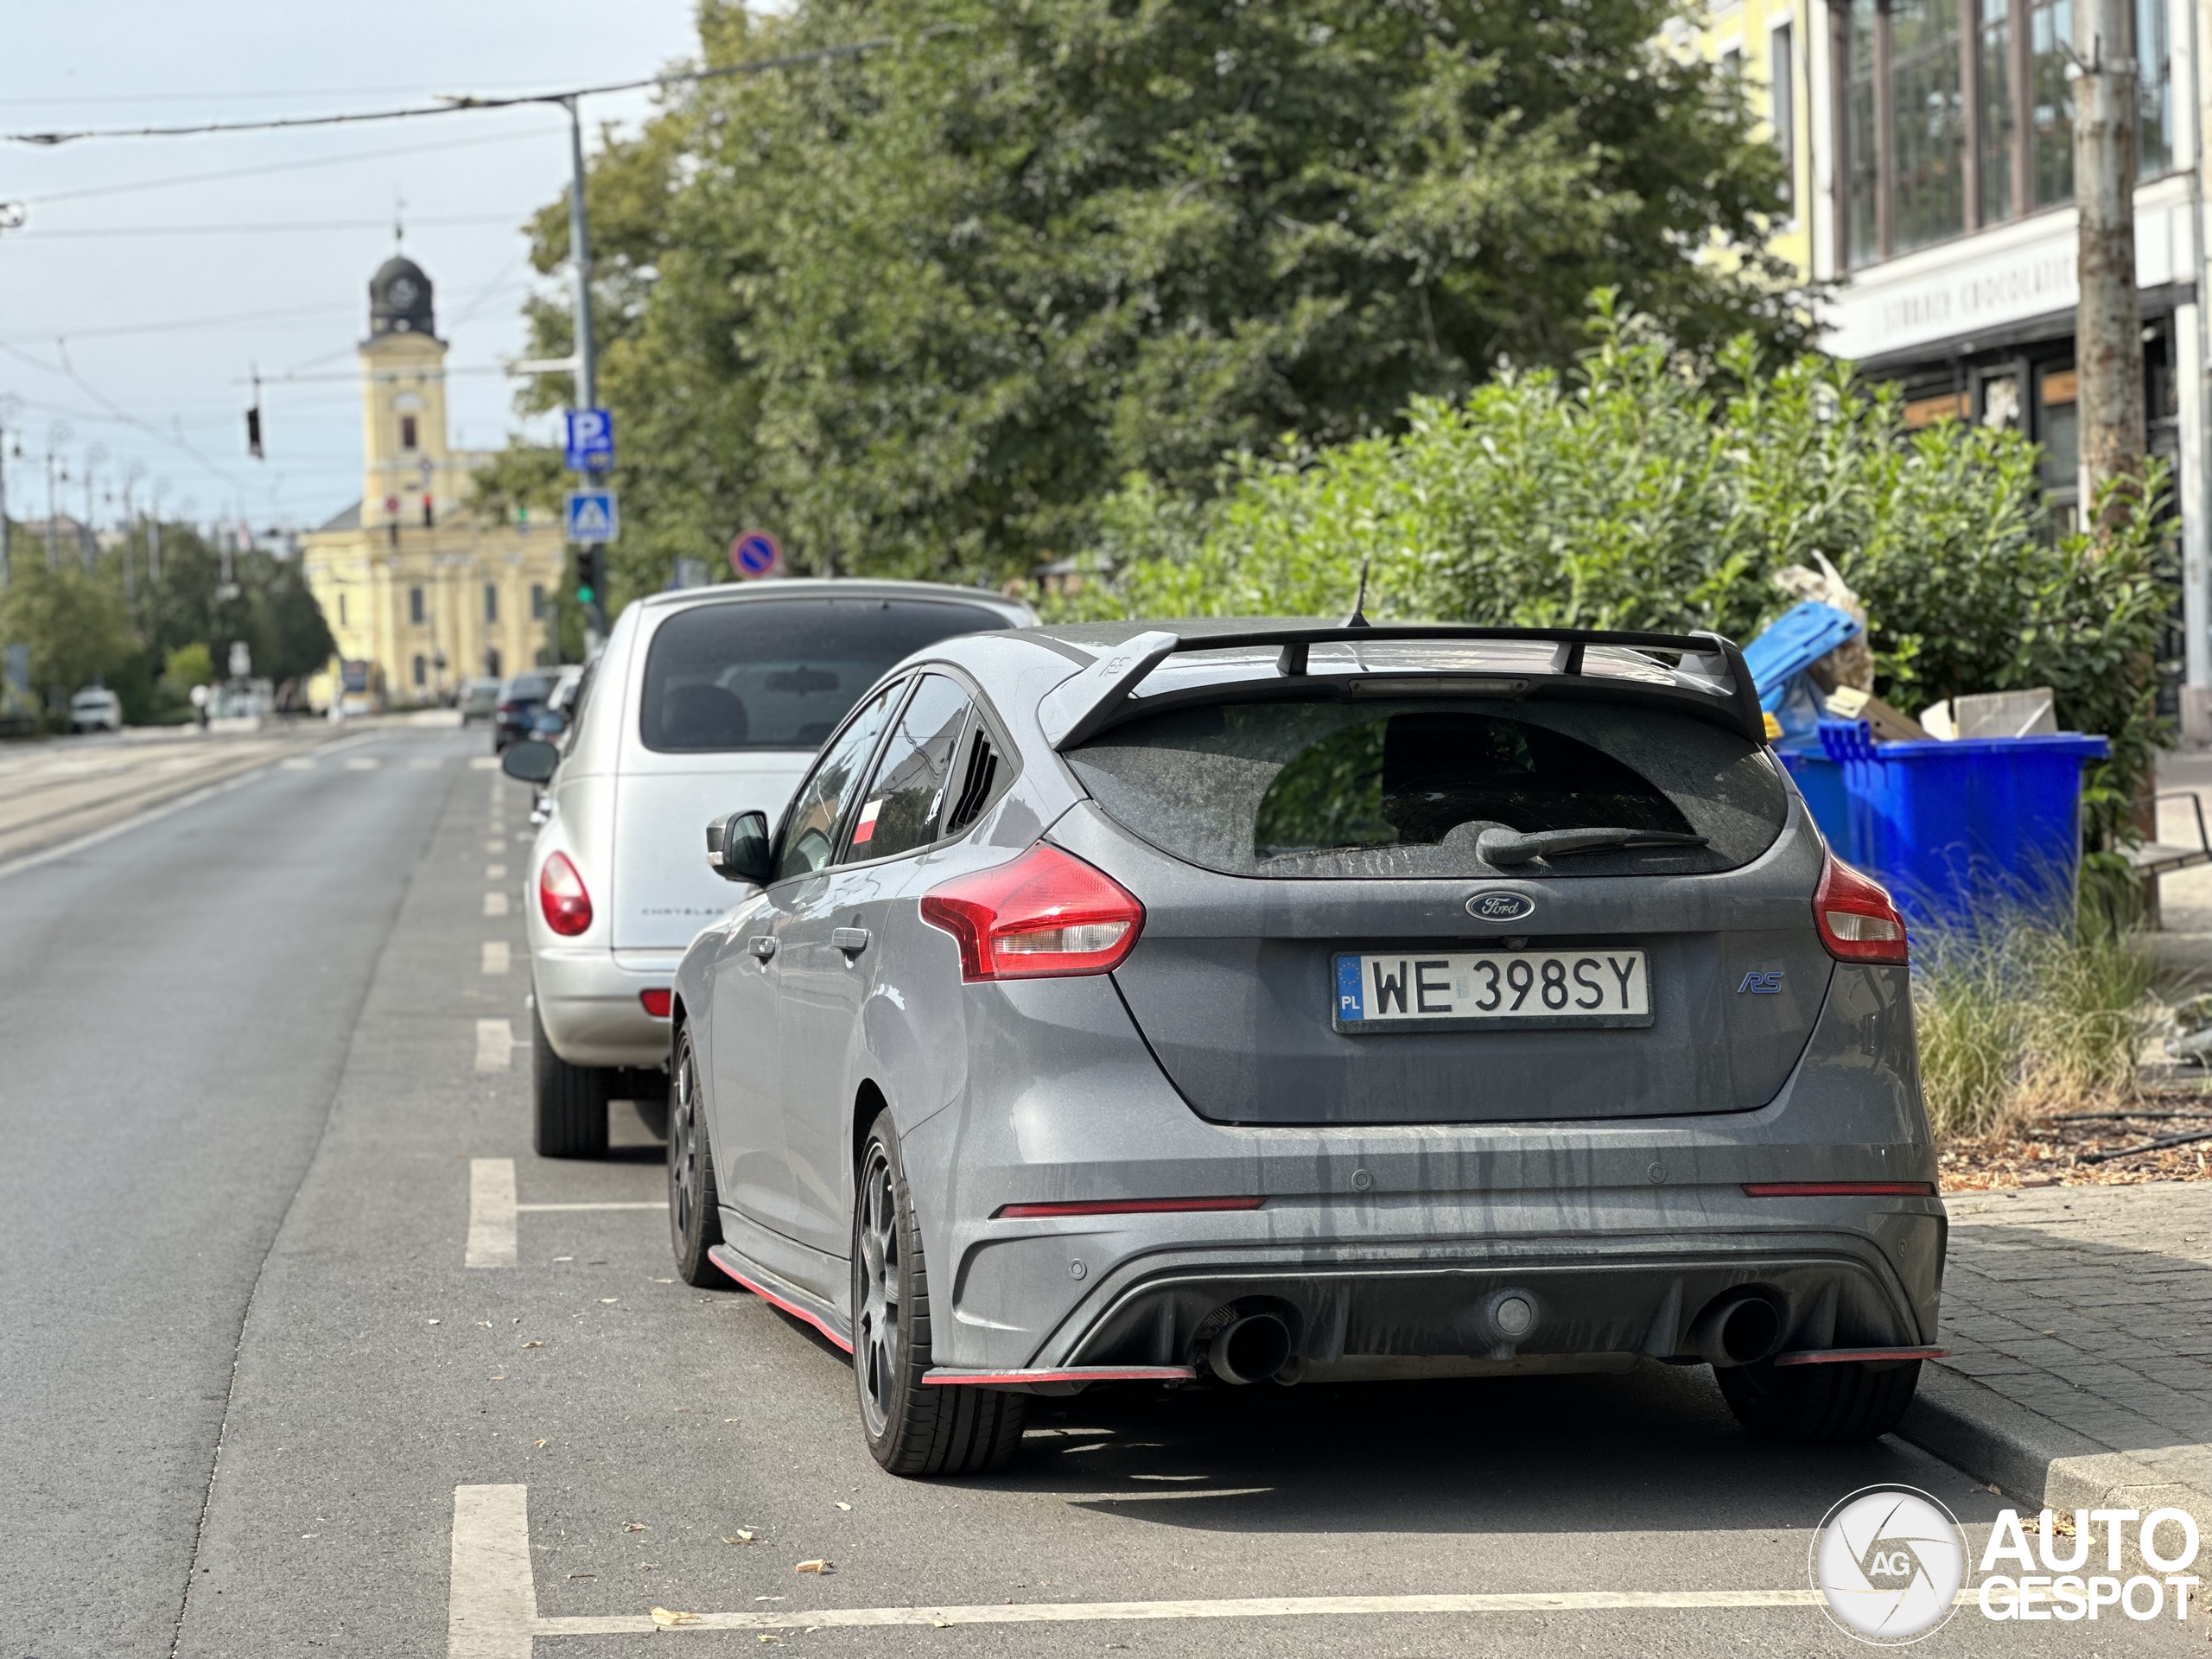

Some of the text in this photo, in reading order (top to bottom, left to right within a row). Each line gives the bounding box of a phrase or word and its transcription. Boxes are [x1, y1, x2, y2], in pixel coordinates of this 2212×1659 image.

[573, 413, 604, 449] P
[1482, 898, 1519, 914] Ford
[1373, 957, 1637, 1014] WE 398SY
[1738, 971, 1784, 993] RS
[1342, 995, 1360, 1010] PL
